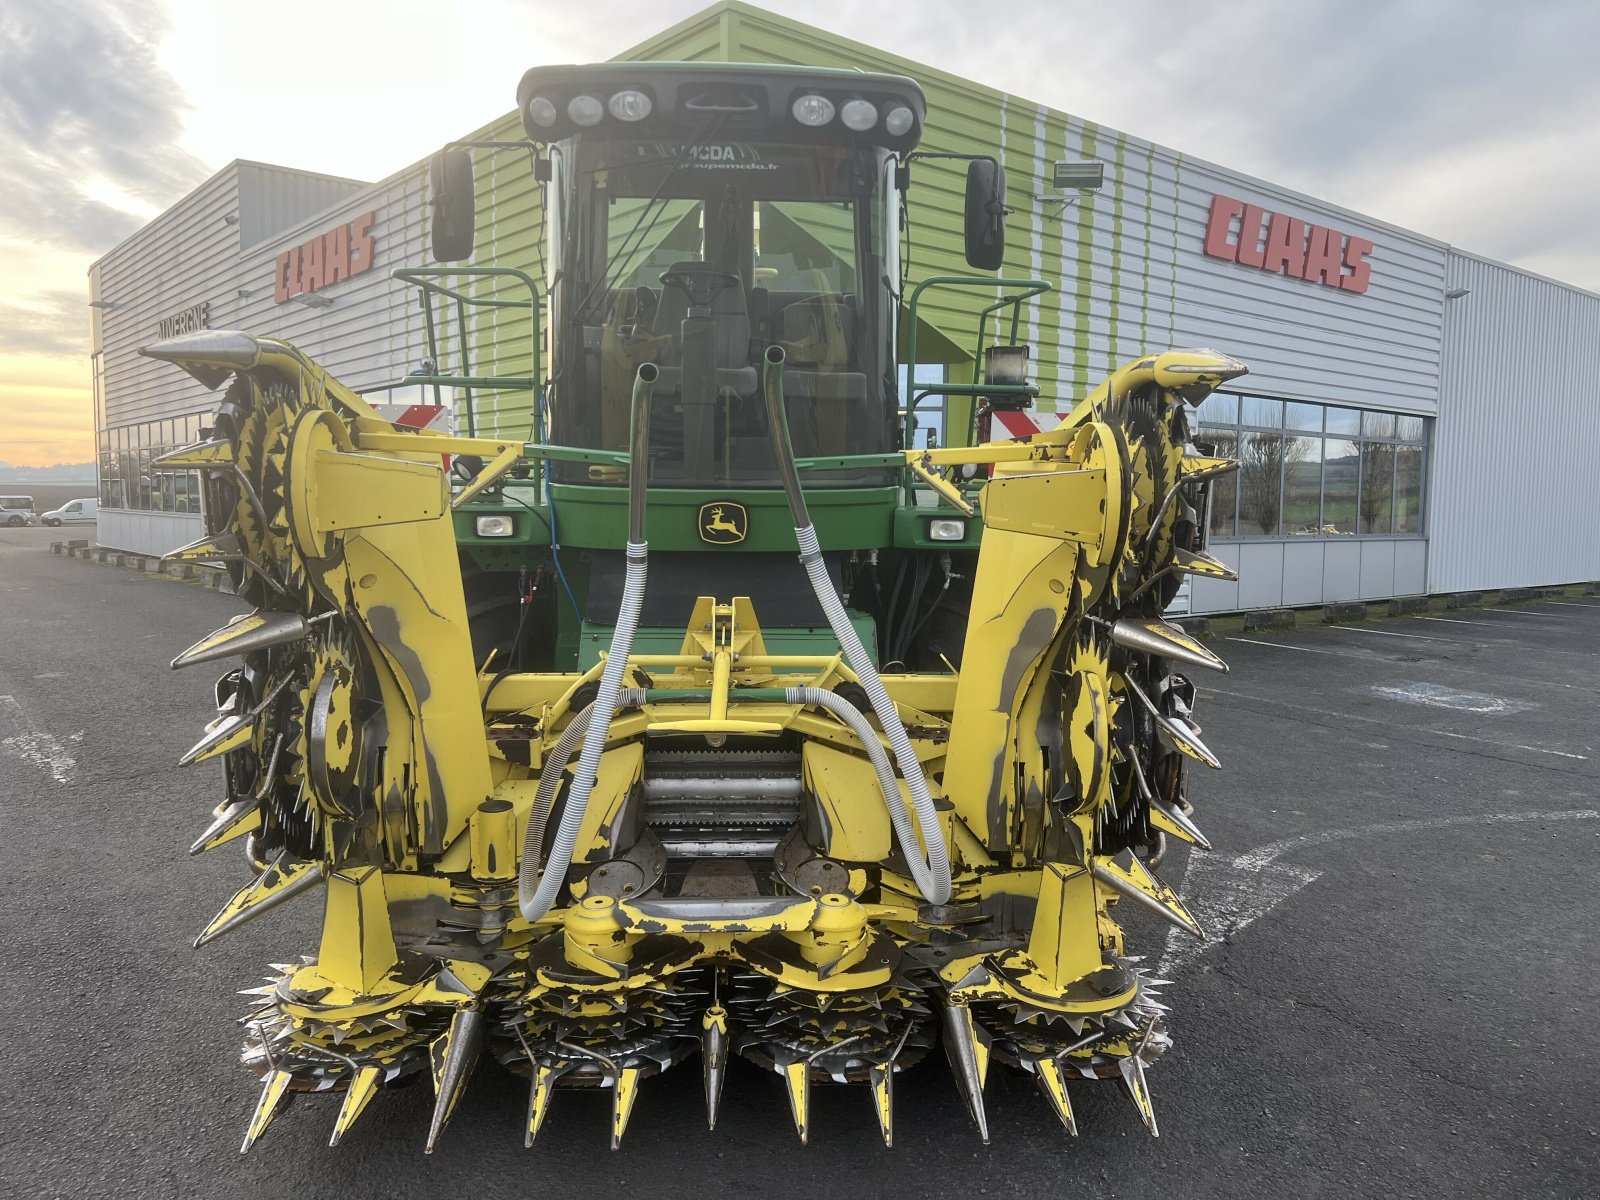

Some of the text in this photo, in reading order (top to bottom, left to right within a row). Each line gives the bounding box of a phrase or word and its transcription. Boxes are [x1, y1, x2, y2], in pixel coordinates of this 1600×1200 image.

[275, 210, 376, 304] CLAAS
[1203, 194, 1373, 294] CLAAS
[157, 302, 209, 340] AUVERGNE
